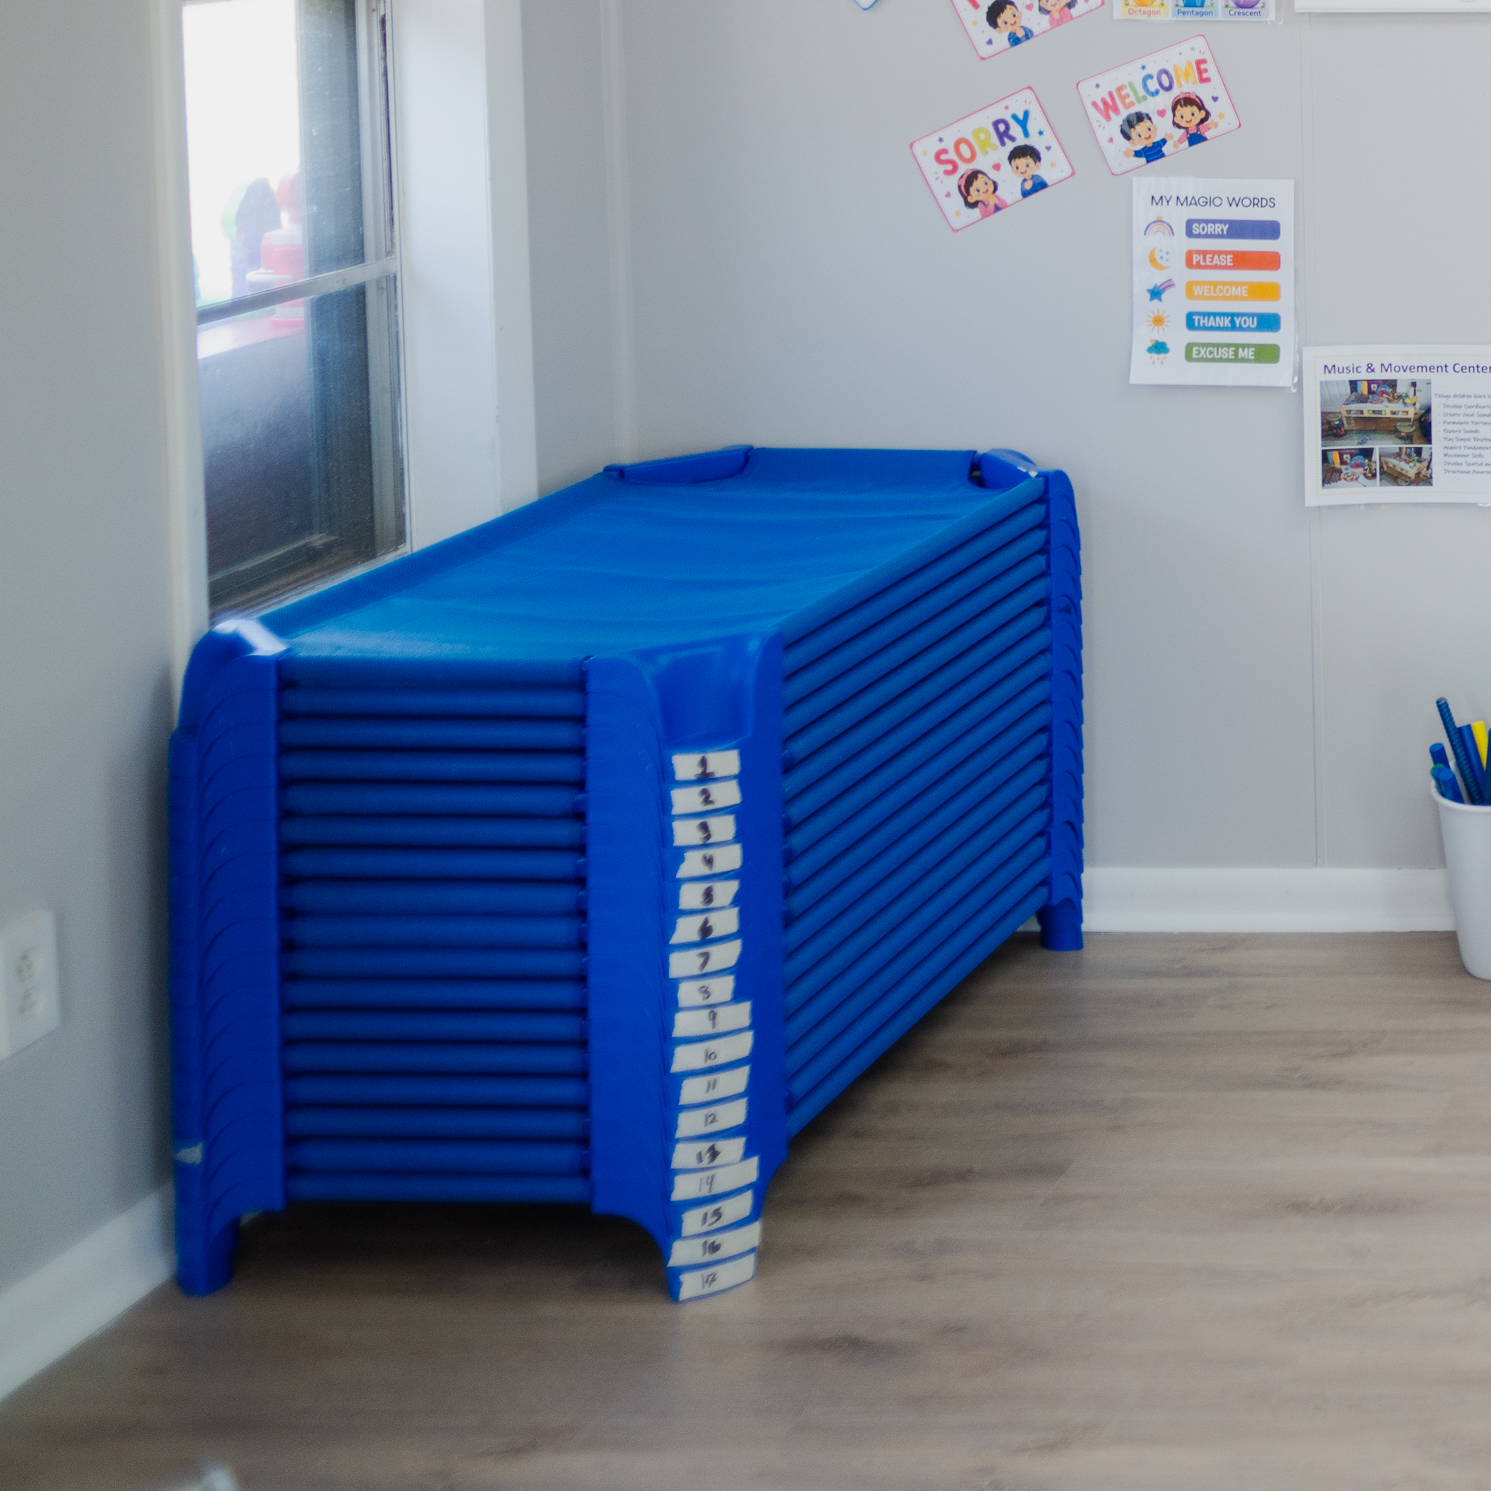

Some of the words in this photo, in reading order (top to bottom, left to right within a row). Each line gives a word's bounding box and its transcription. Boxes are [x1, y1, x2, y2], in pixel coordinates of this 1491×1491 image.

[1128, 8, 1161, 16] Octagon
[1178, 9, 1213, 17] Pentagon
[1229, 9, 1261, 17] Crescent
[1091, 58, 1211, 123] WELCOME
[934, 110, 1032, 176] SORRY
[1151, 195, 1172, 206] MY
[1176, 196, 1223, 207] MAGIC
[1227, 197, 1276, 208] WORDS
[1193, 224, 1229, 235] SORRY
[1193, 254, 1233, 266] PLEASE
[1193, 285, 1248, 297] WELCOME
[1193, 316, 1231, 328] THANK
[1234, 317, 1257, 328] YOU
[1193, 347, 1235, 358] EXCUSE
[1238, 348, 1255, 359] ME
[1323, 364, 1362, 374] Music
[1366, 363, 1376, 373] &
[1380, 363, 1449, 373] Movement
[704, 1113, 717, 1127] 12
[701, 1206, 722, 1227] 15
